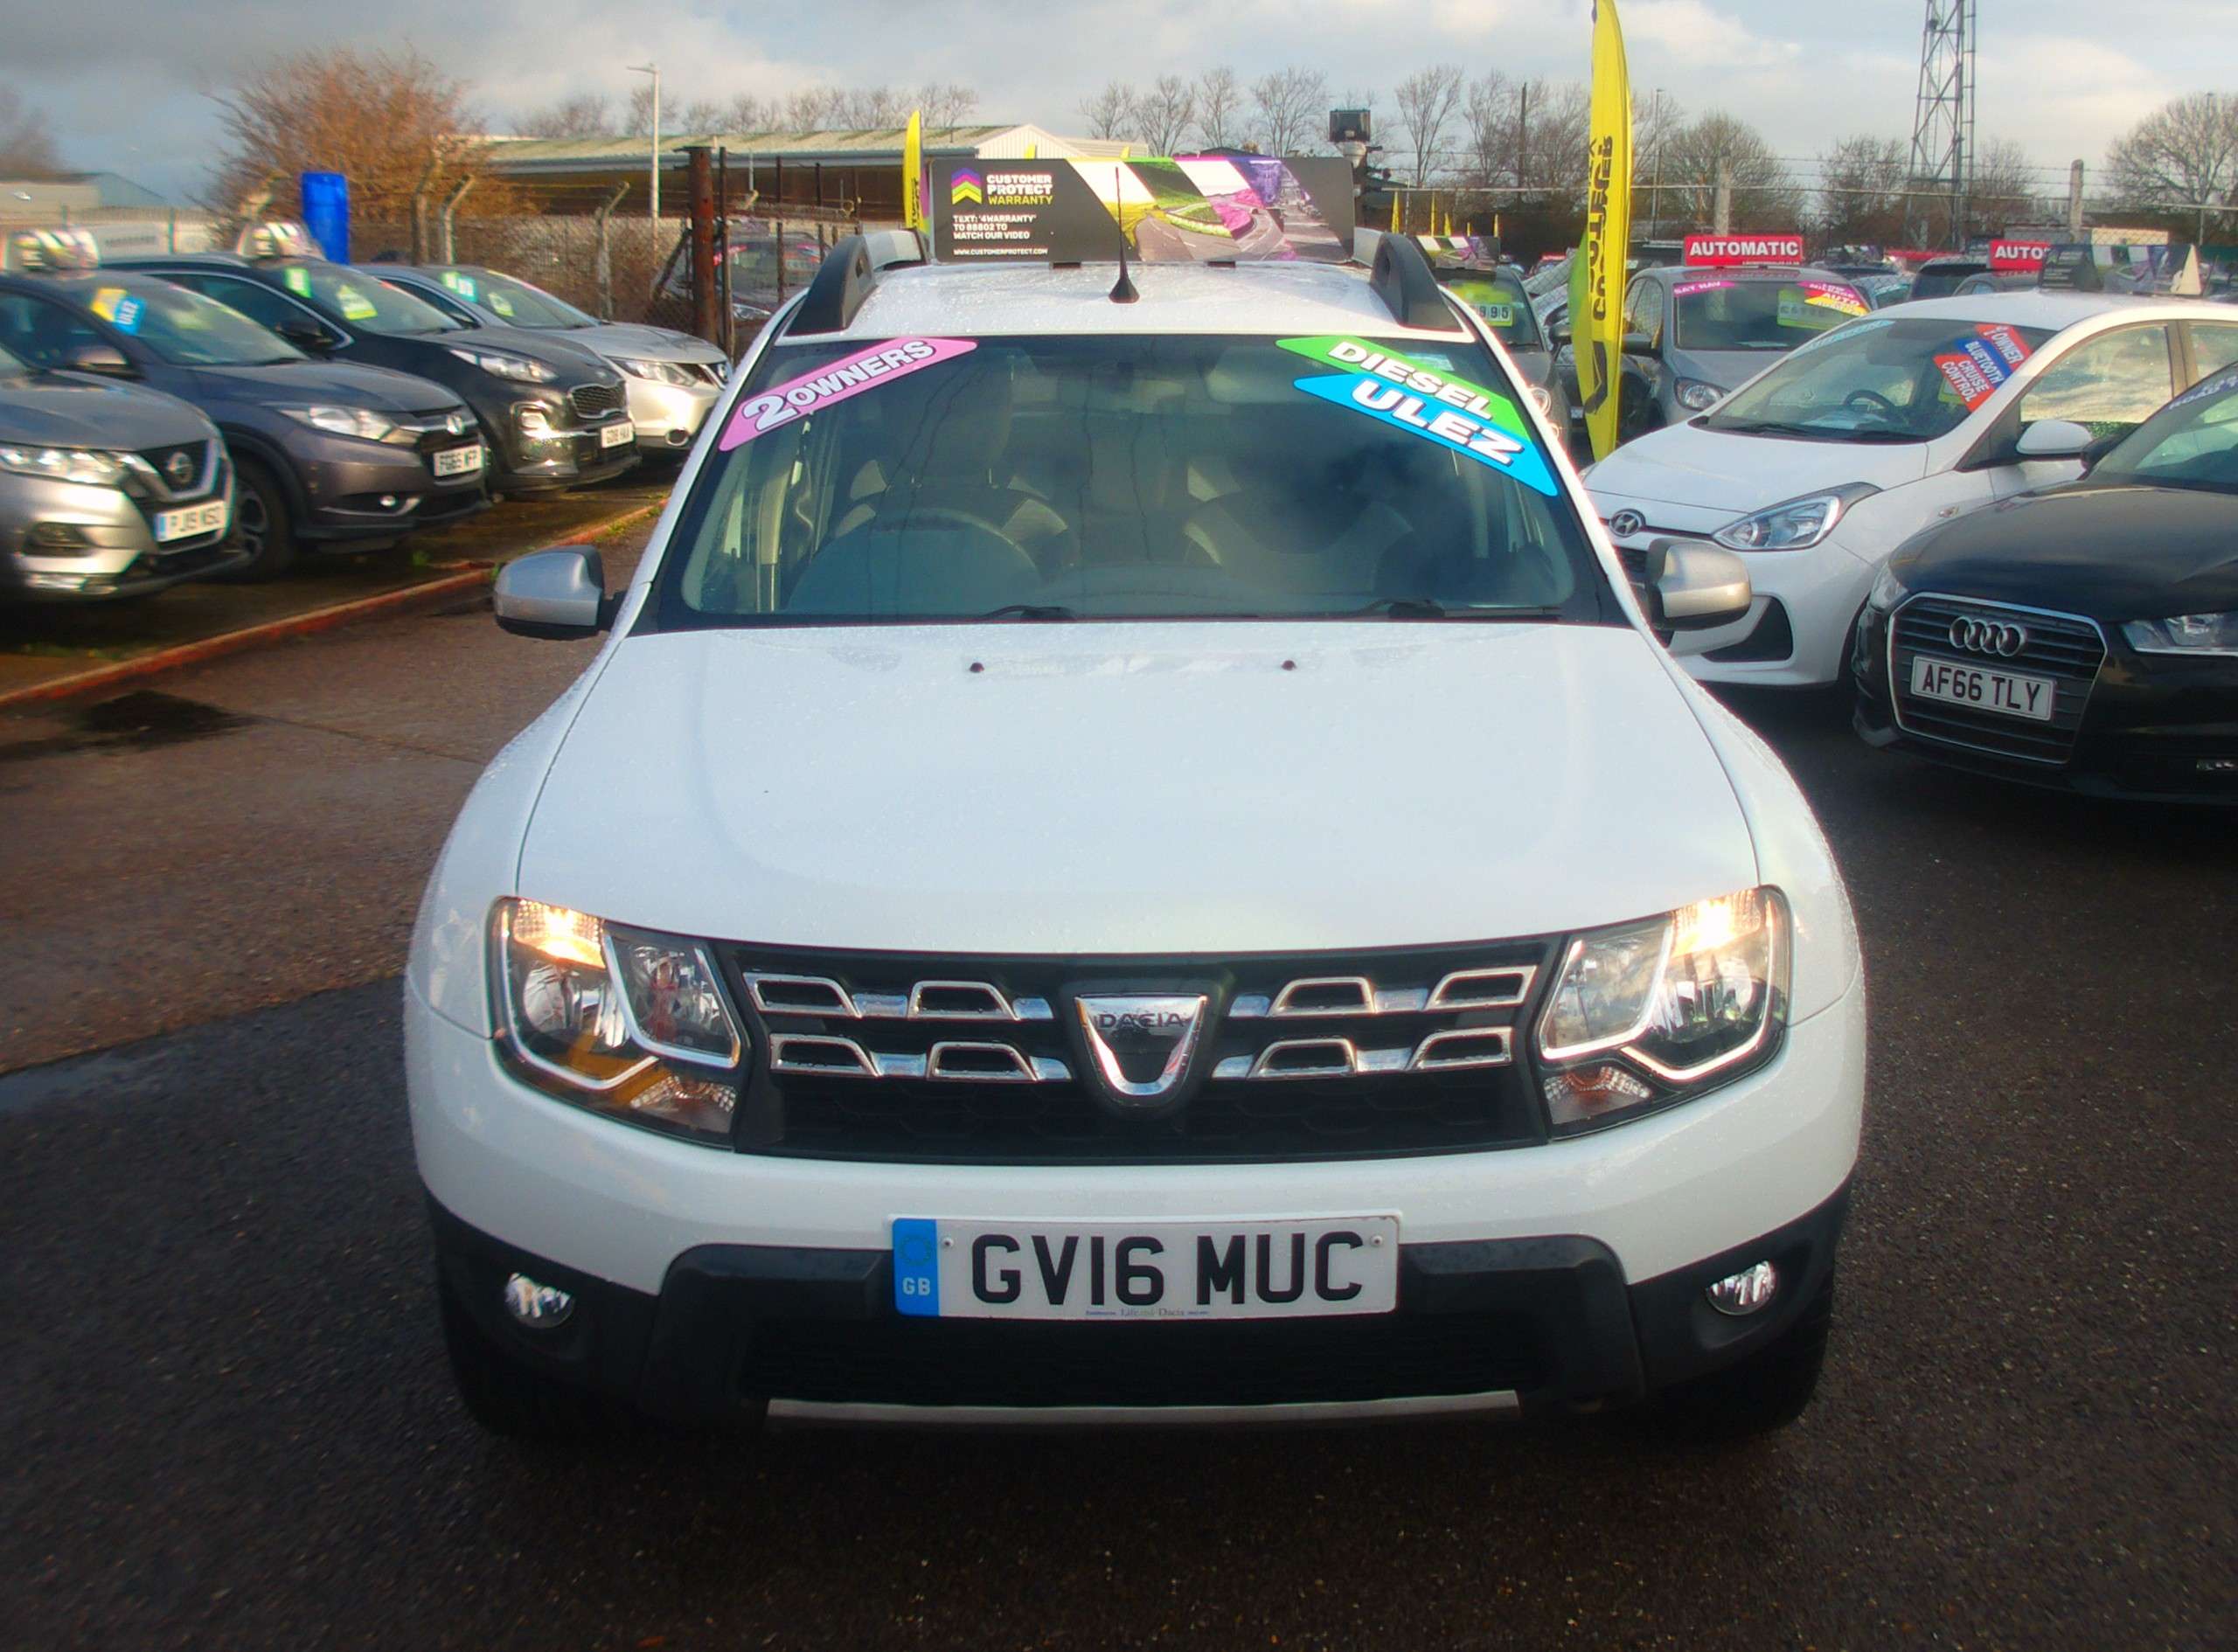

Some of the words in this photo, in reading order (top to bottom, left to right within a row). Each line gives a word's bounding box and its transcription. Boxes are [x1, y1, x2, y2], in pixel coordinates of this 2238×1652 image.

[986, 174, 1052, 184] CUSTOMER
[987, 184, 1053, 195] PROTECT
[988, 196, 1053, 205] WARRANTY
[1689, 241, 1799, 256] AUTOMATIC
[1822, 292, 1860, 306] AUTO
[1964, 340, 2005, 385] BLUETOOTH
[1991, 332, 2025, 364] OWNER
[786, 340, 935, 407] OWNERS
[1326, 341, 1493, 420] DIESEL
[1941, 360, 1977, 402] CONTROL
[1958, 359, 1990, 393] CRUISE
[1351, 378, 1525, 466] ULEZ
[1922, 663, 1983, 701] AF66
[1991, 676, 2041, 712] TLY
[1099, 1013, 1184, 1028] DACIA
[971, 1233, 1164, 1306] GV16
[1195, 1231, 1364, 1305] MUC
[902, 1276, 931, 1296] GB
